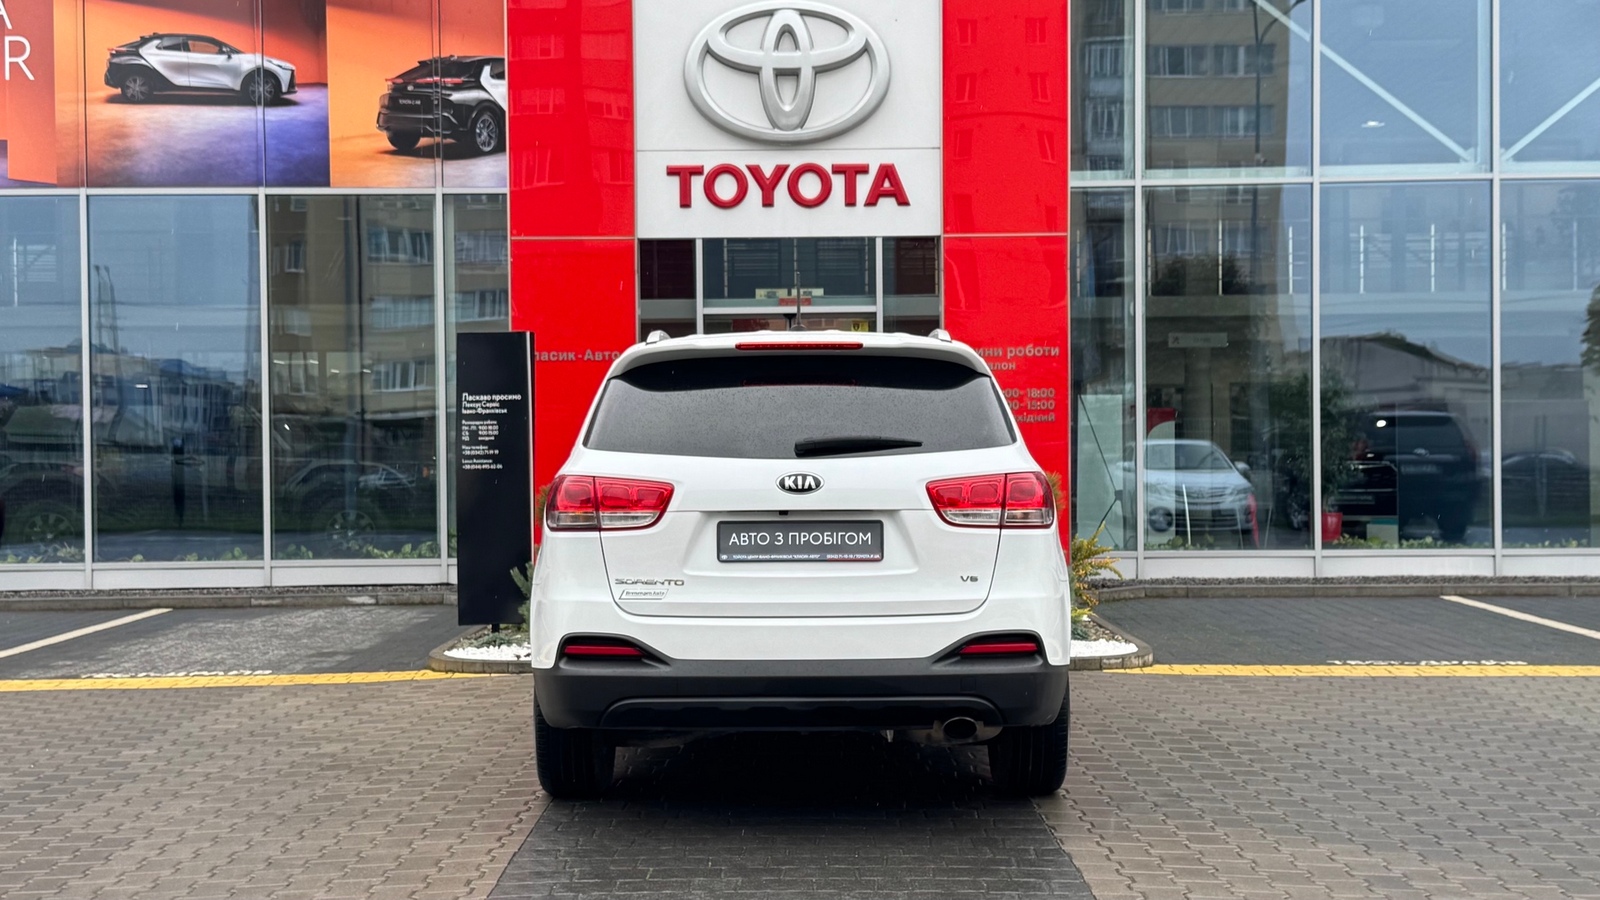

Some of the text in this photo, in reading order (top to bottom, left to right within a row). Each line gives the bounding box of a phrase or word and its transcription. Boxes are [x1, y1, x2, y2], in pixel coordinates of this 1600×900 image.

[666, 163, 911, 209] TOYOTA
[1007, 344, 1060, 359] роботи
[492, 394, 522, 402] просимо
[784, 475, 816, 490] KIA
[729, 531, 872, 546] АВТО З ПРОБІГОМ
[615, 578, 685, 586] SORENTO
